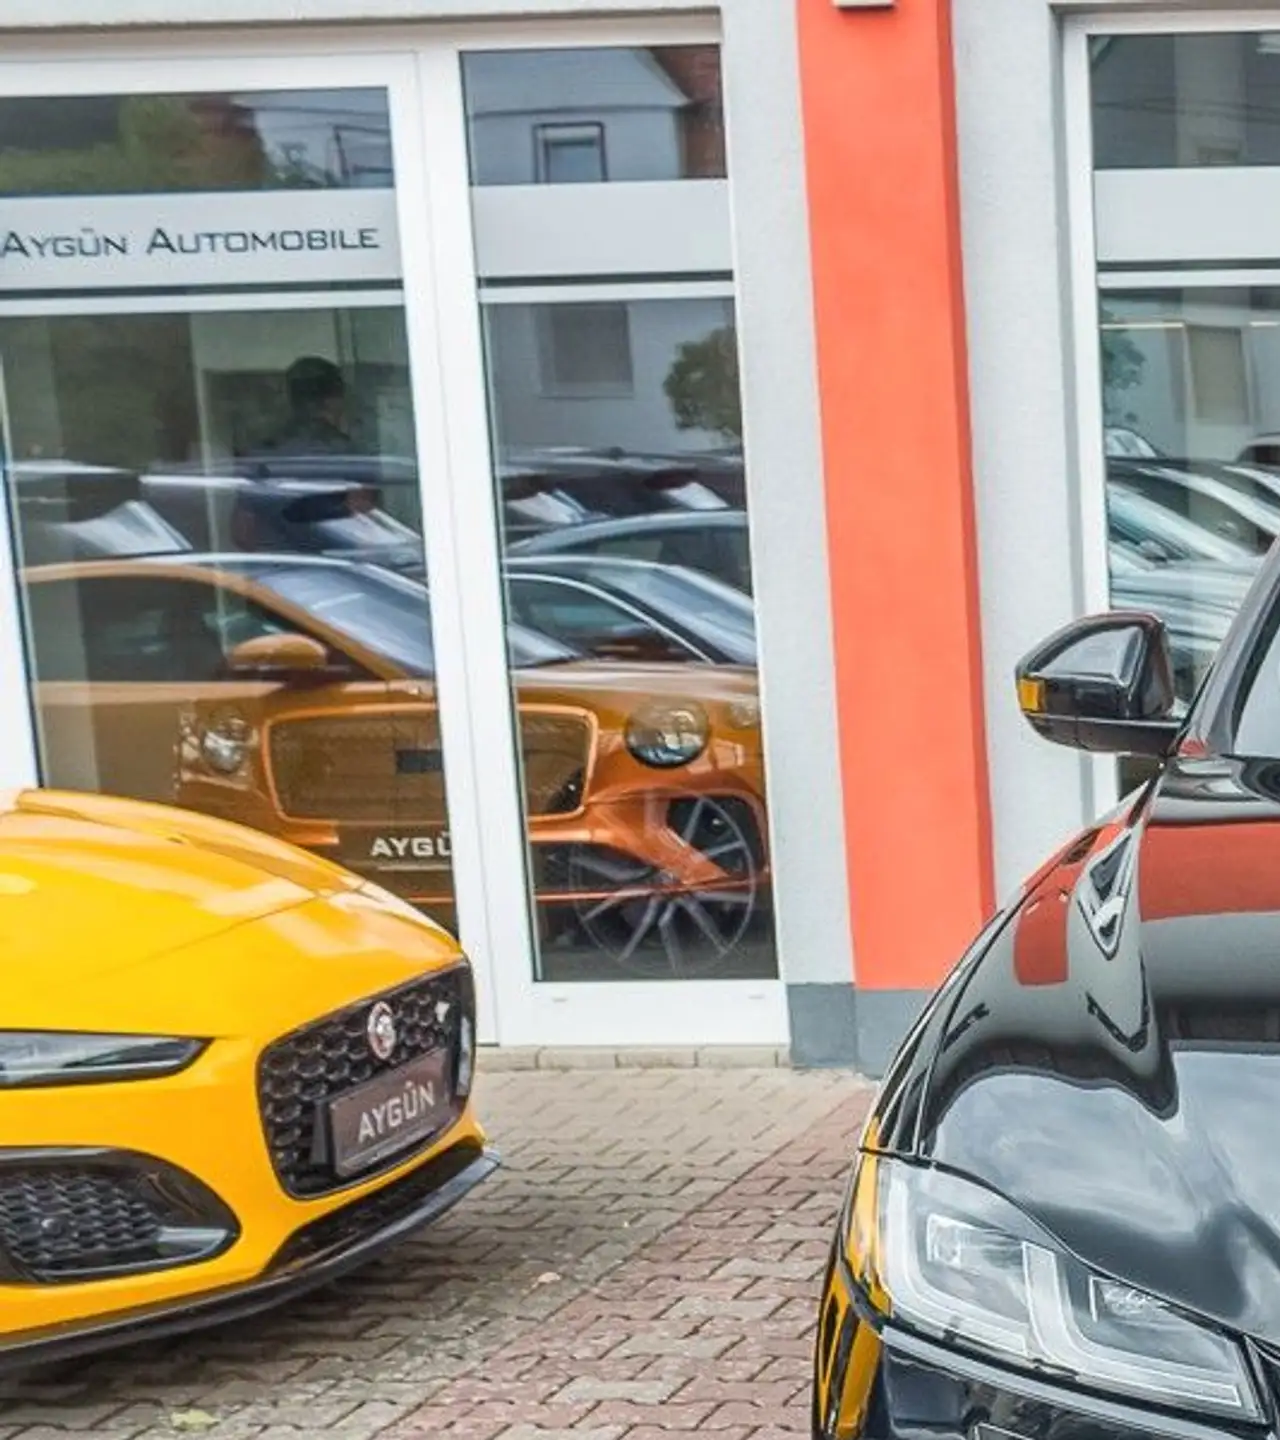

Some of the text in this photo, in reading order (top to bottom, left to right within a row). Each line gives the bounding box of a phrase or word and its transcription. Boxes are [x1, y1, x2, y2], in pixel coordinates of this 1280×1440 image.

[0, 227, 381, 258] AYGÜN AUTOMOBILE
[370, 831, 453, 857] AYGÜ
[358, 1080, 436, 1144] AYGÜN
